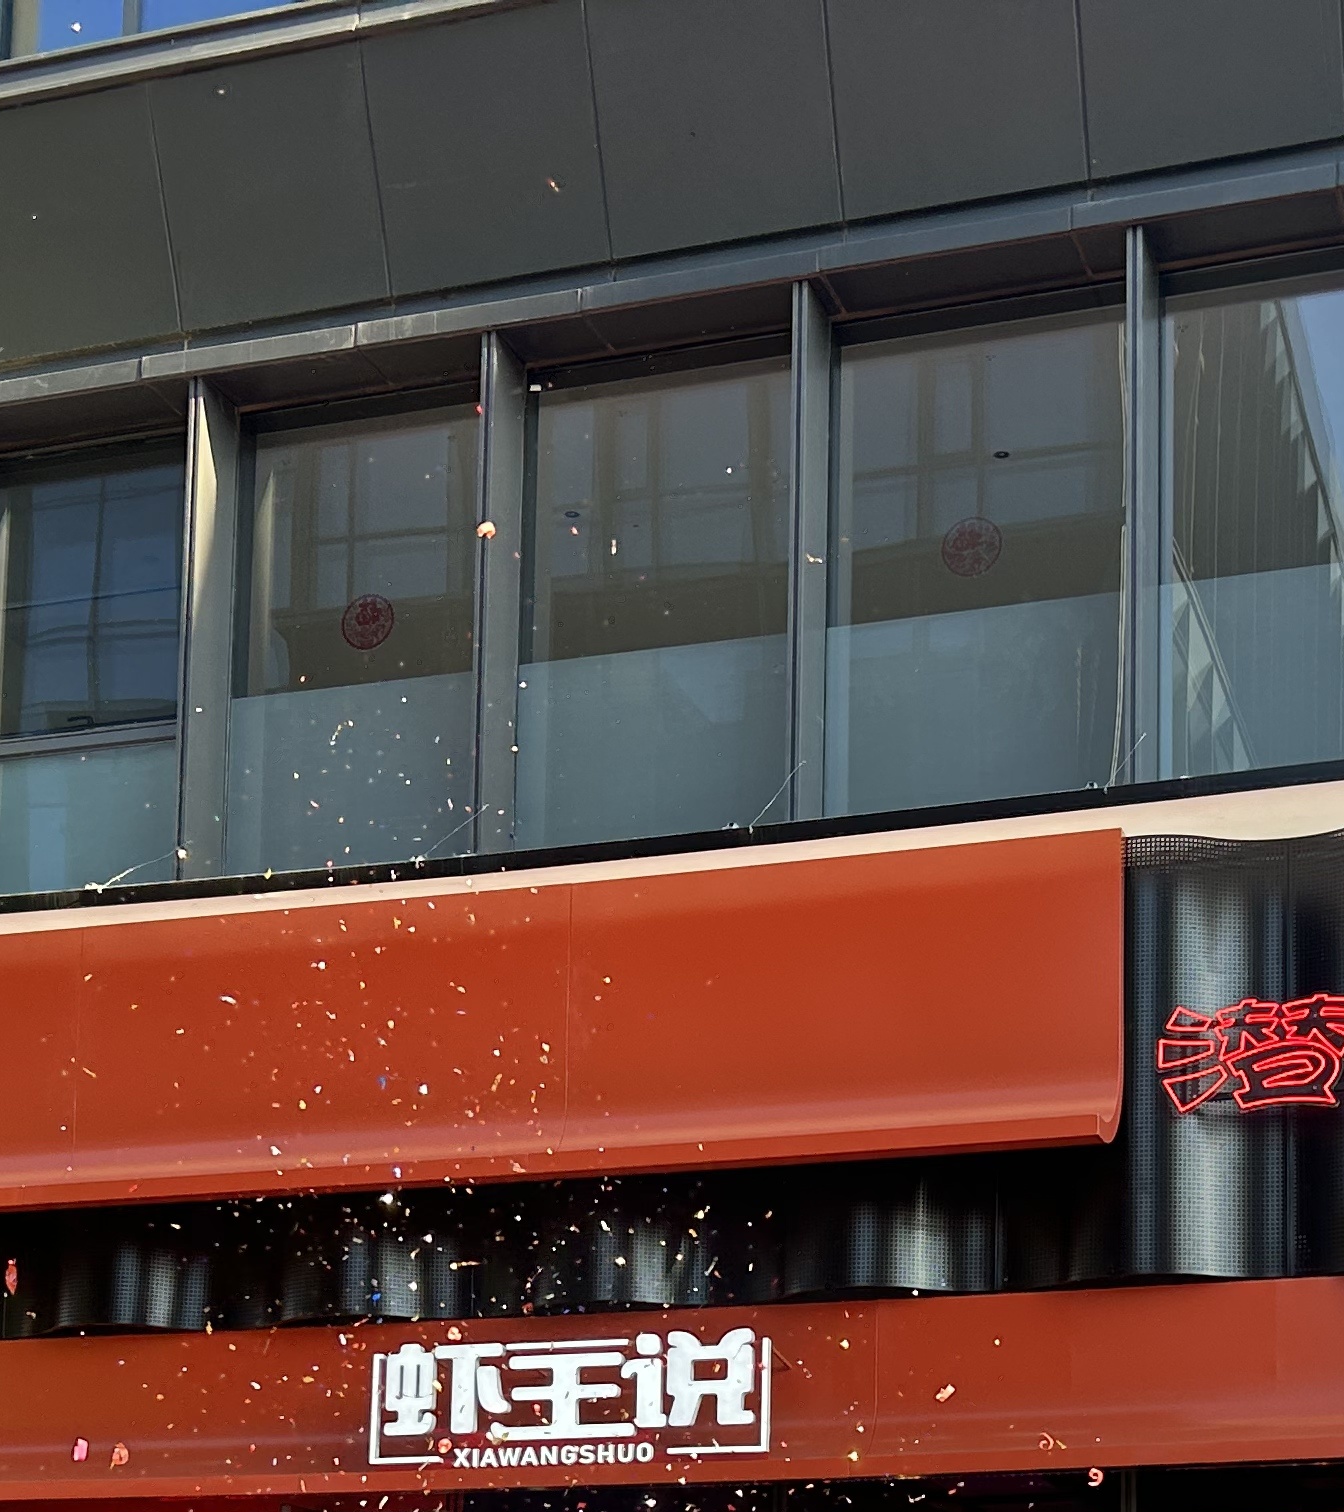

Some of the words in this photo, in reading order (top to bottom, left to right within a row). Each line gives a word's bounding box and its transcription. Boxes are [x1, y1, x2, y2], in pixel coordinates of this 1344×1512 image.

[383, 1327, 755, 1440] 虾王说
[453, 1443, 654, 1468] XIAWANGSHUO
